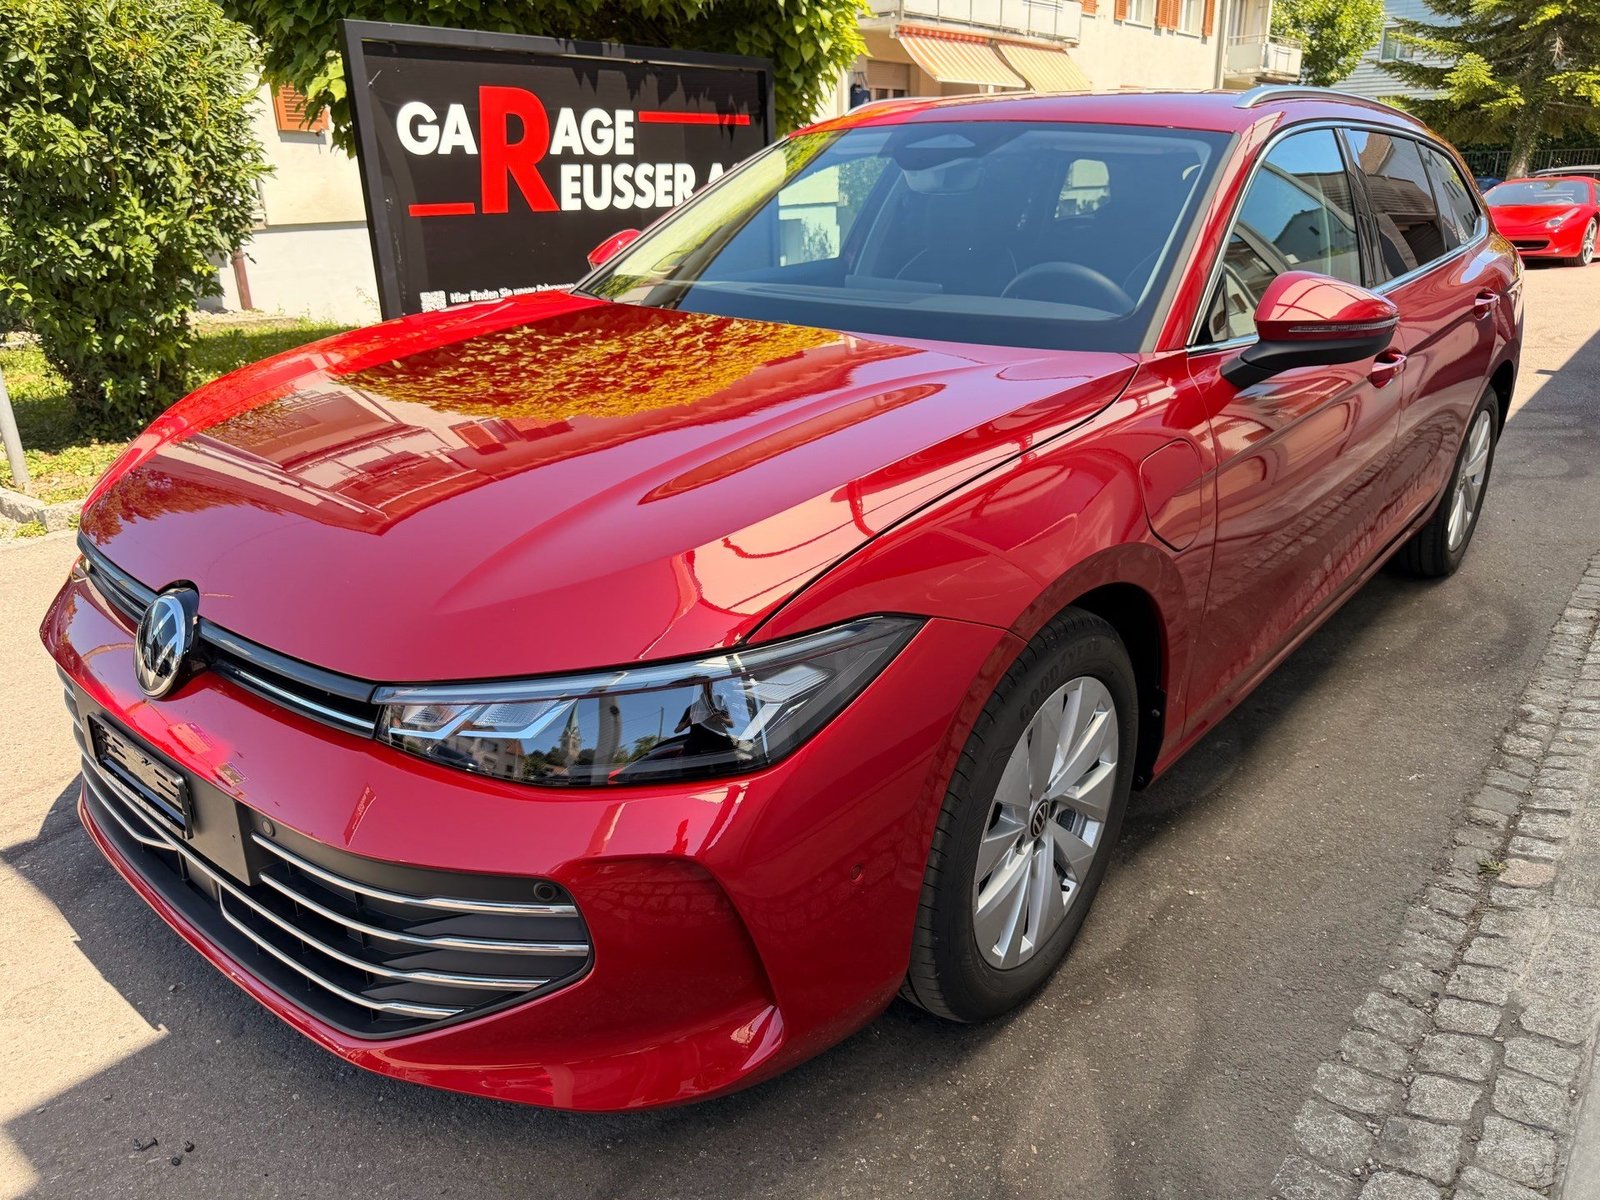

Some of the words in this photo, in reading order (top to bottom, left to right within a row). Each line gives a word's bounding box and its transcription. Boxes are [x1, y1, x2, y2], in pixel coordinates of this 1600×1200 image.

[396, 86, 635, 214] GARAGE
[450, 291, 470, 303] Hier
[470, 286, 499, 301] finden
